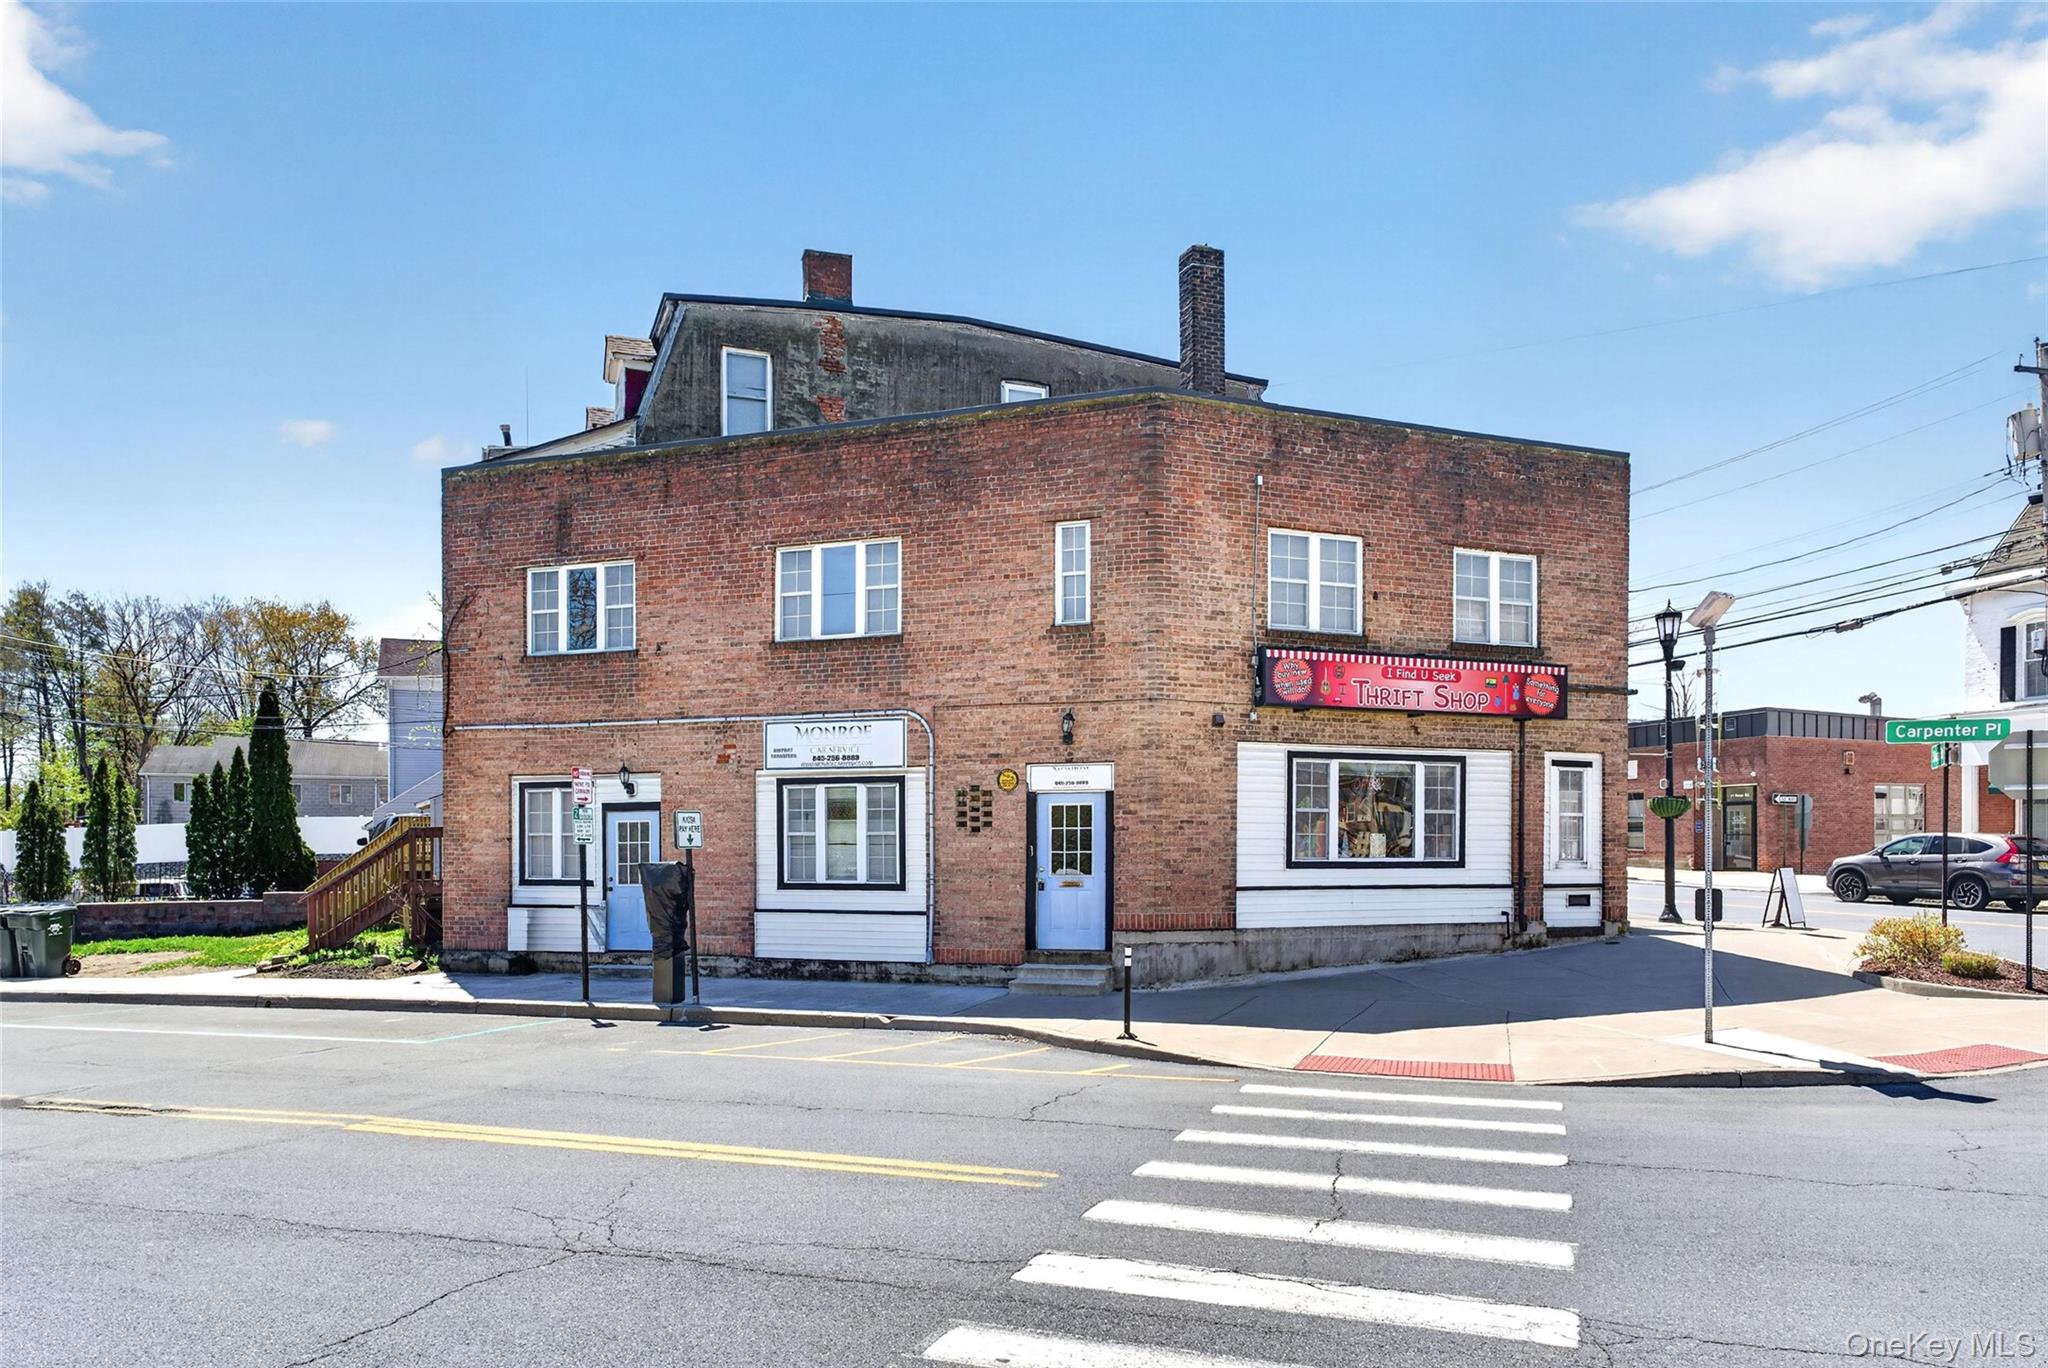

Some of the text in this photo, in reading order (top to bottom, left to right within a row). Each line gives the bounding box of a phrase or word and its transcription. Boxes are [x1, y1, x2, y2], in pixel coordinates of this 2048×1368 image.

[1387, 669, 1456, 681] I Find U Seek
[1526, 677, 1560, 695] Something
[794, 724, 873, 741] MONROE
[1895, 723, 2002, 740] Carpenter Pl
[679, 824, 701, 833] PAY HERE
